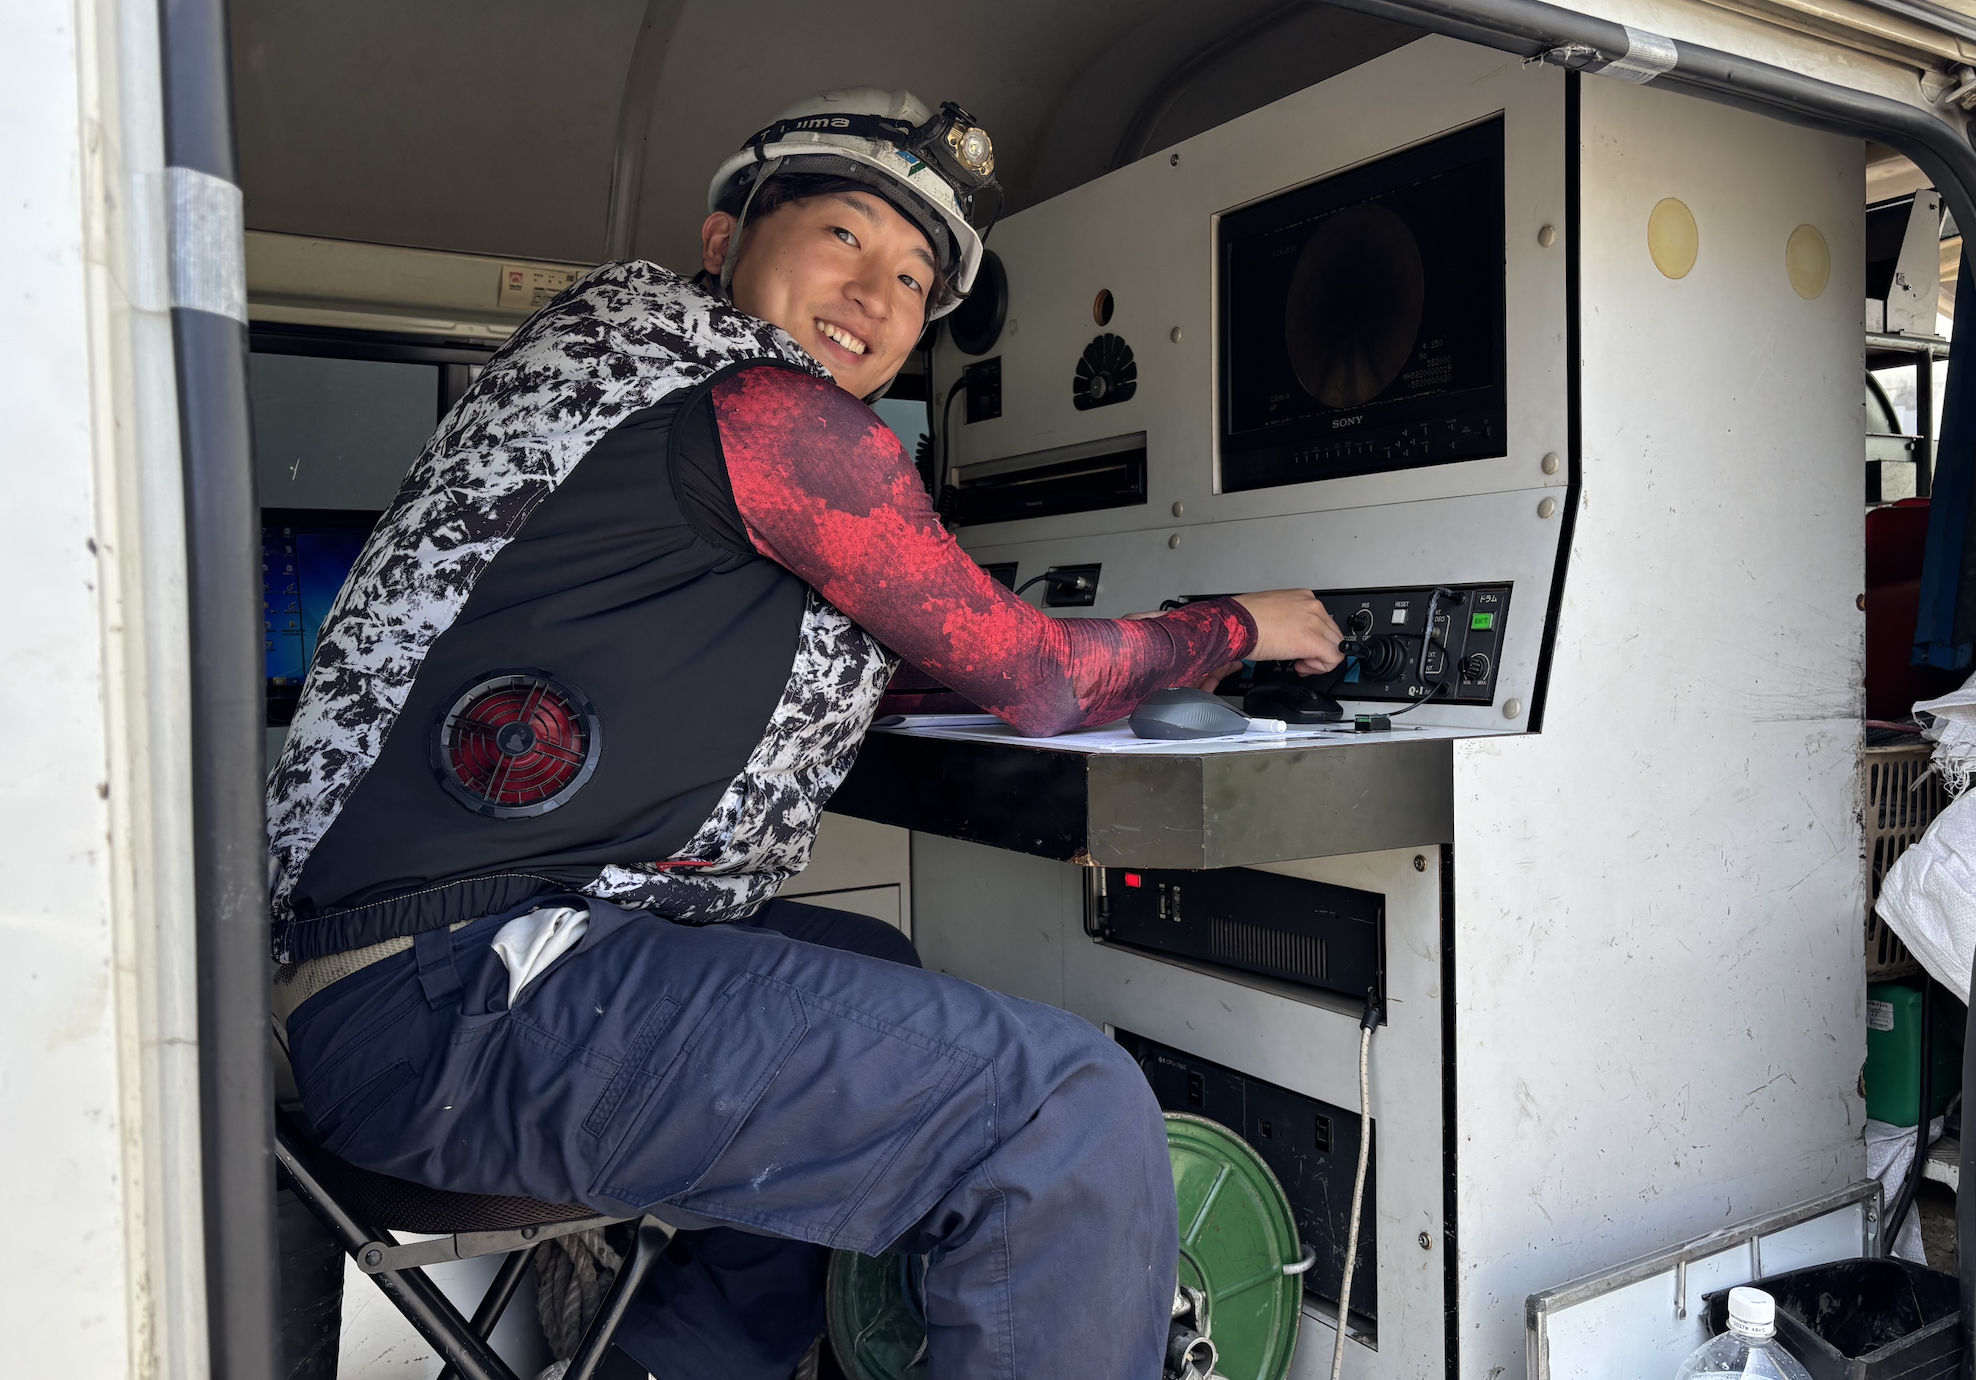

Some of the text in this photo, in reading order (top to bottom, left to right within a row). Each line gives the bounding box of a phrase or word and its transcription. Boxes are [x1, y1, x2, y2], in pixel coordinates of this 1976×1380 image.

[1332, 415, 1363, 429] SONY
[1479, 594, 1498, 604] ドラム
